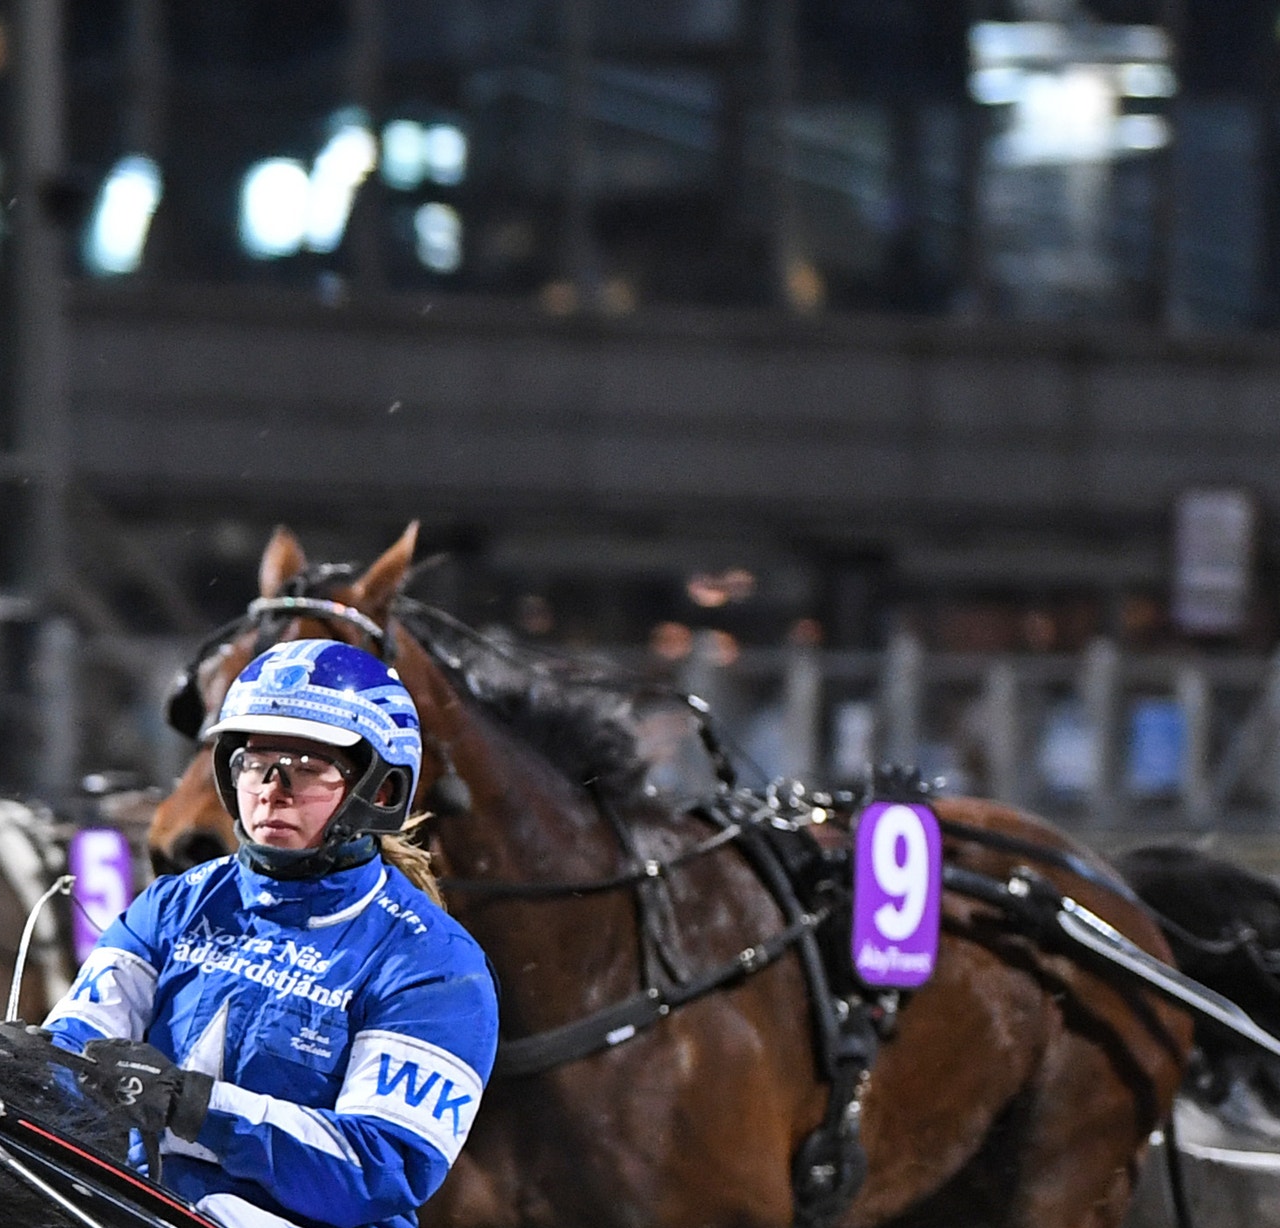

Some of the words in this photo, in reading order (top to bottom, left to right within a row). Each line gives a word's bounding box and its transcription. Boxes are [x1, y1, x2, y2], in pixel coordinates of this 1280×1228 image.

[82, 829, 127, 933] 5
[873, 805, 929, 940] 9
[173, 936, 354, 1012] ädgårdstjänst
[274, 939, 331, 973] Näs
[376, 1052, 473, 1137] WK
